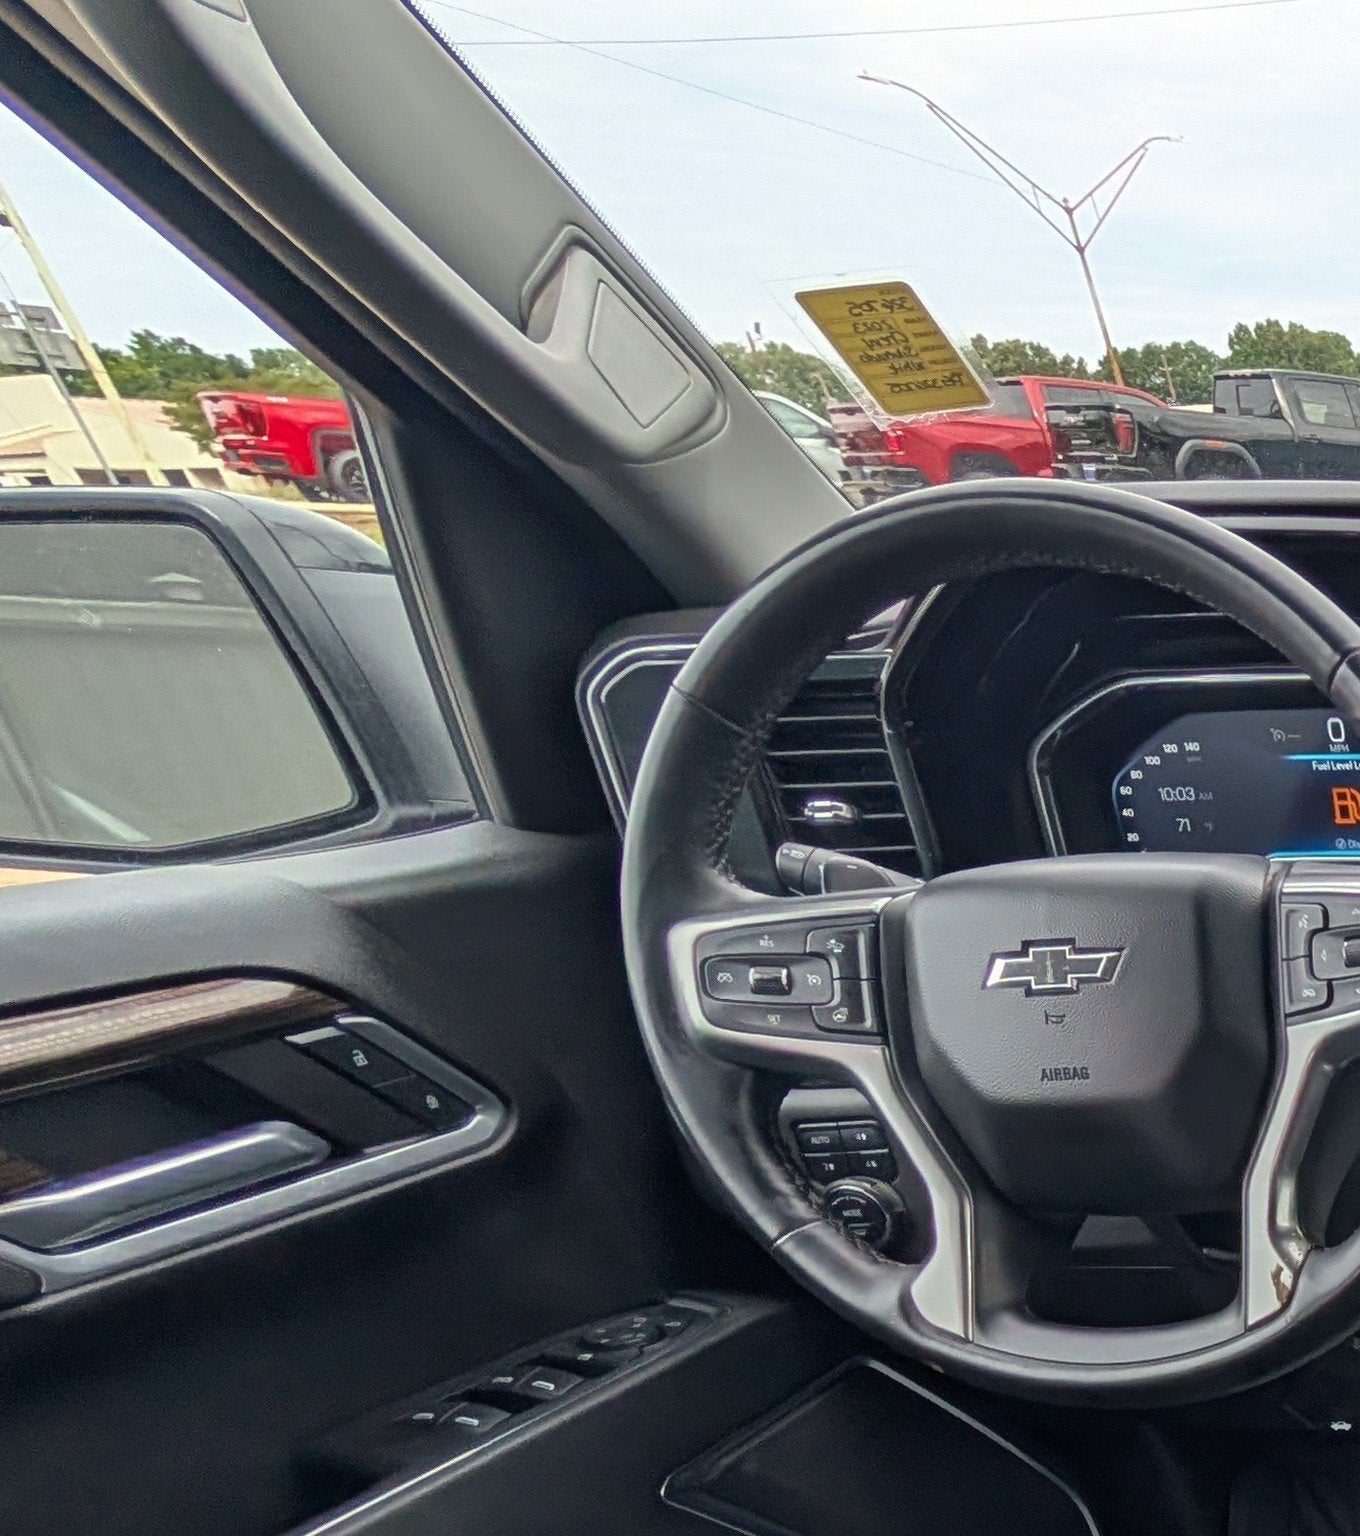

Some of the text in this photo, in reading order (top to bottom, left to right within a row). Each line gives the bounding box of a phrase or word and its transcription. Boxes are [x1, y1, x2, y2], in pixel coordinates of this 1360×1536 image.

[1326, 716, 1345, 743] 0
[1162, 743, 1178, 753] 120
[1183, 742, 1200, 752] 140
[1144, 756, 1161, 766] 100
[1312, 760, 1331, 771] Fuel
[1332, 761, 1353, 771] Level
[1158, 786, 1196, 802] 10:03
[1041, 1066, 1090, 1081] AIRBAG
